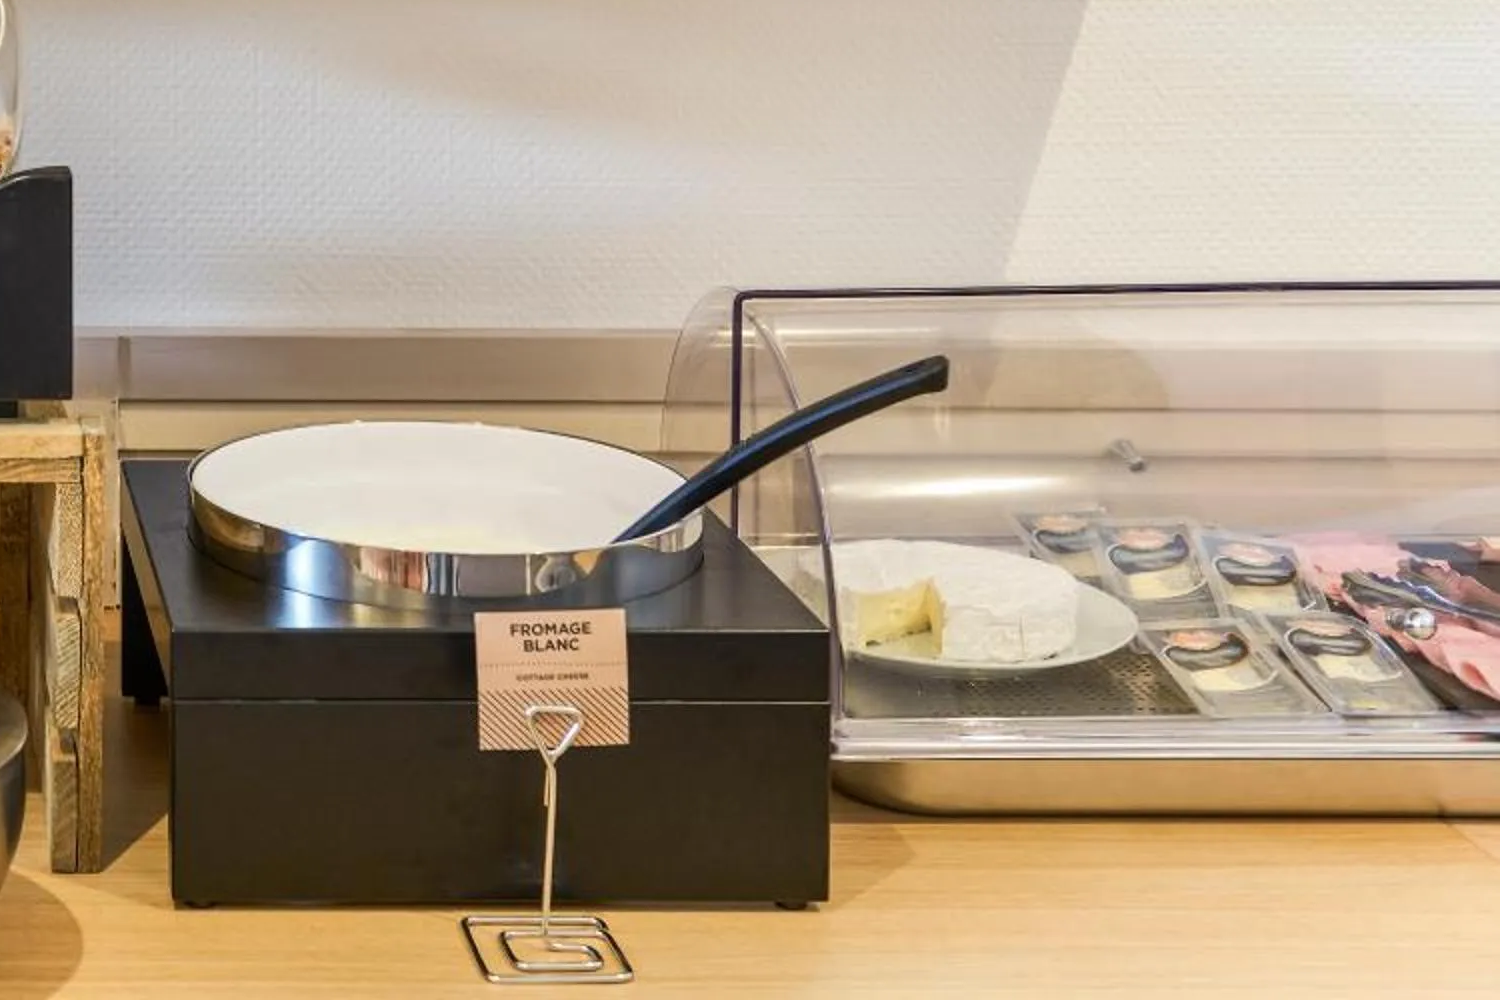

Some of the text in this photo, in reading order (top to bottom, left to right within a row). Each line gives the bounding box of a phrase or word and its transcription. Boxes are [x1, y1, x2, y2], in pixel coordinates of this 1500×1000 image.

[509, 621, 591, 636] FROMAGE
[523, 638, 580, 652] BLANC
[516, 672, 589, 681] COTTAGE CHEESE
